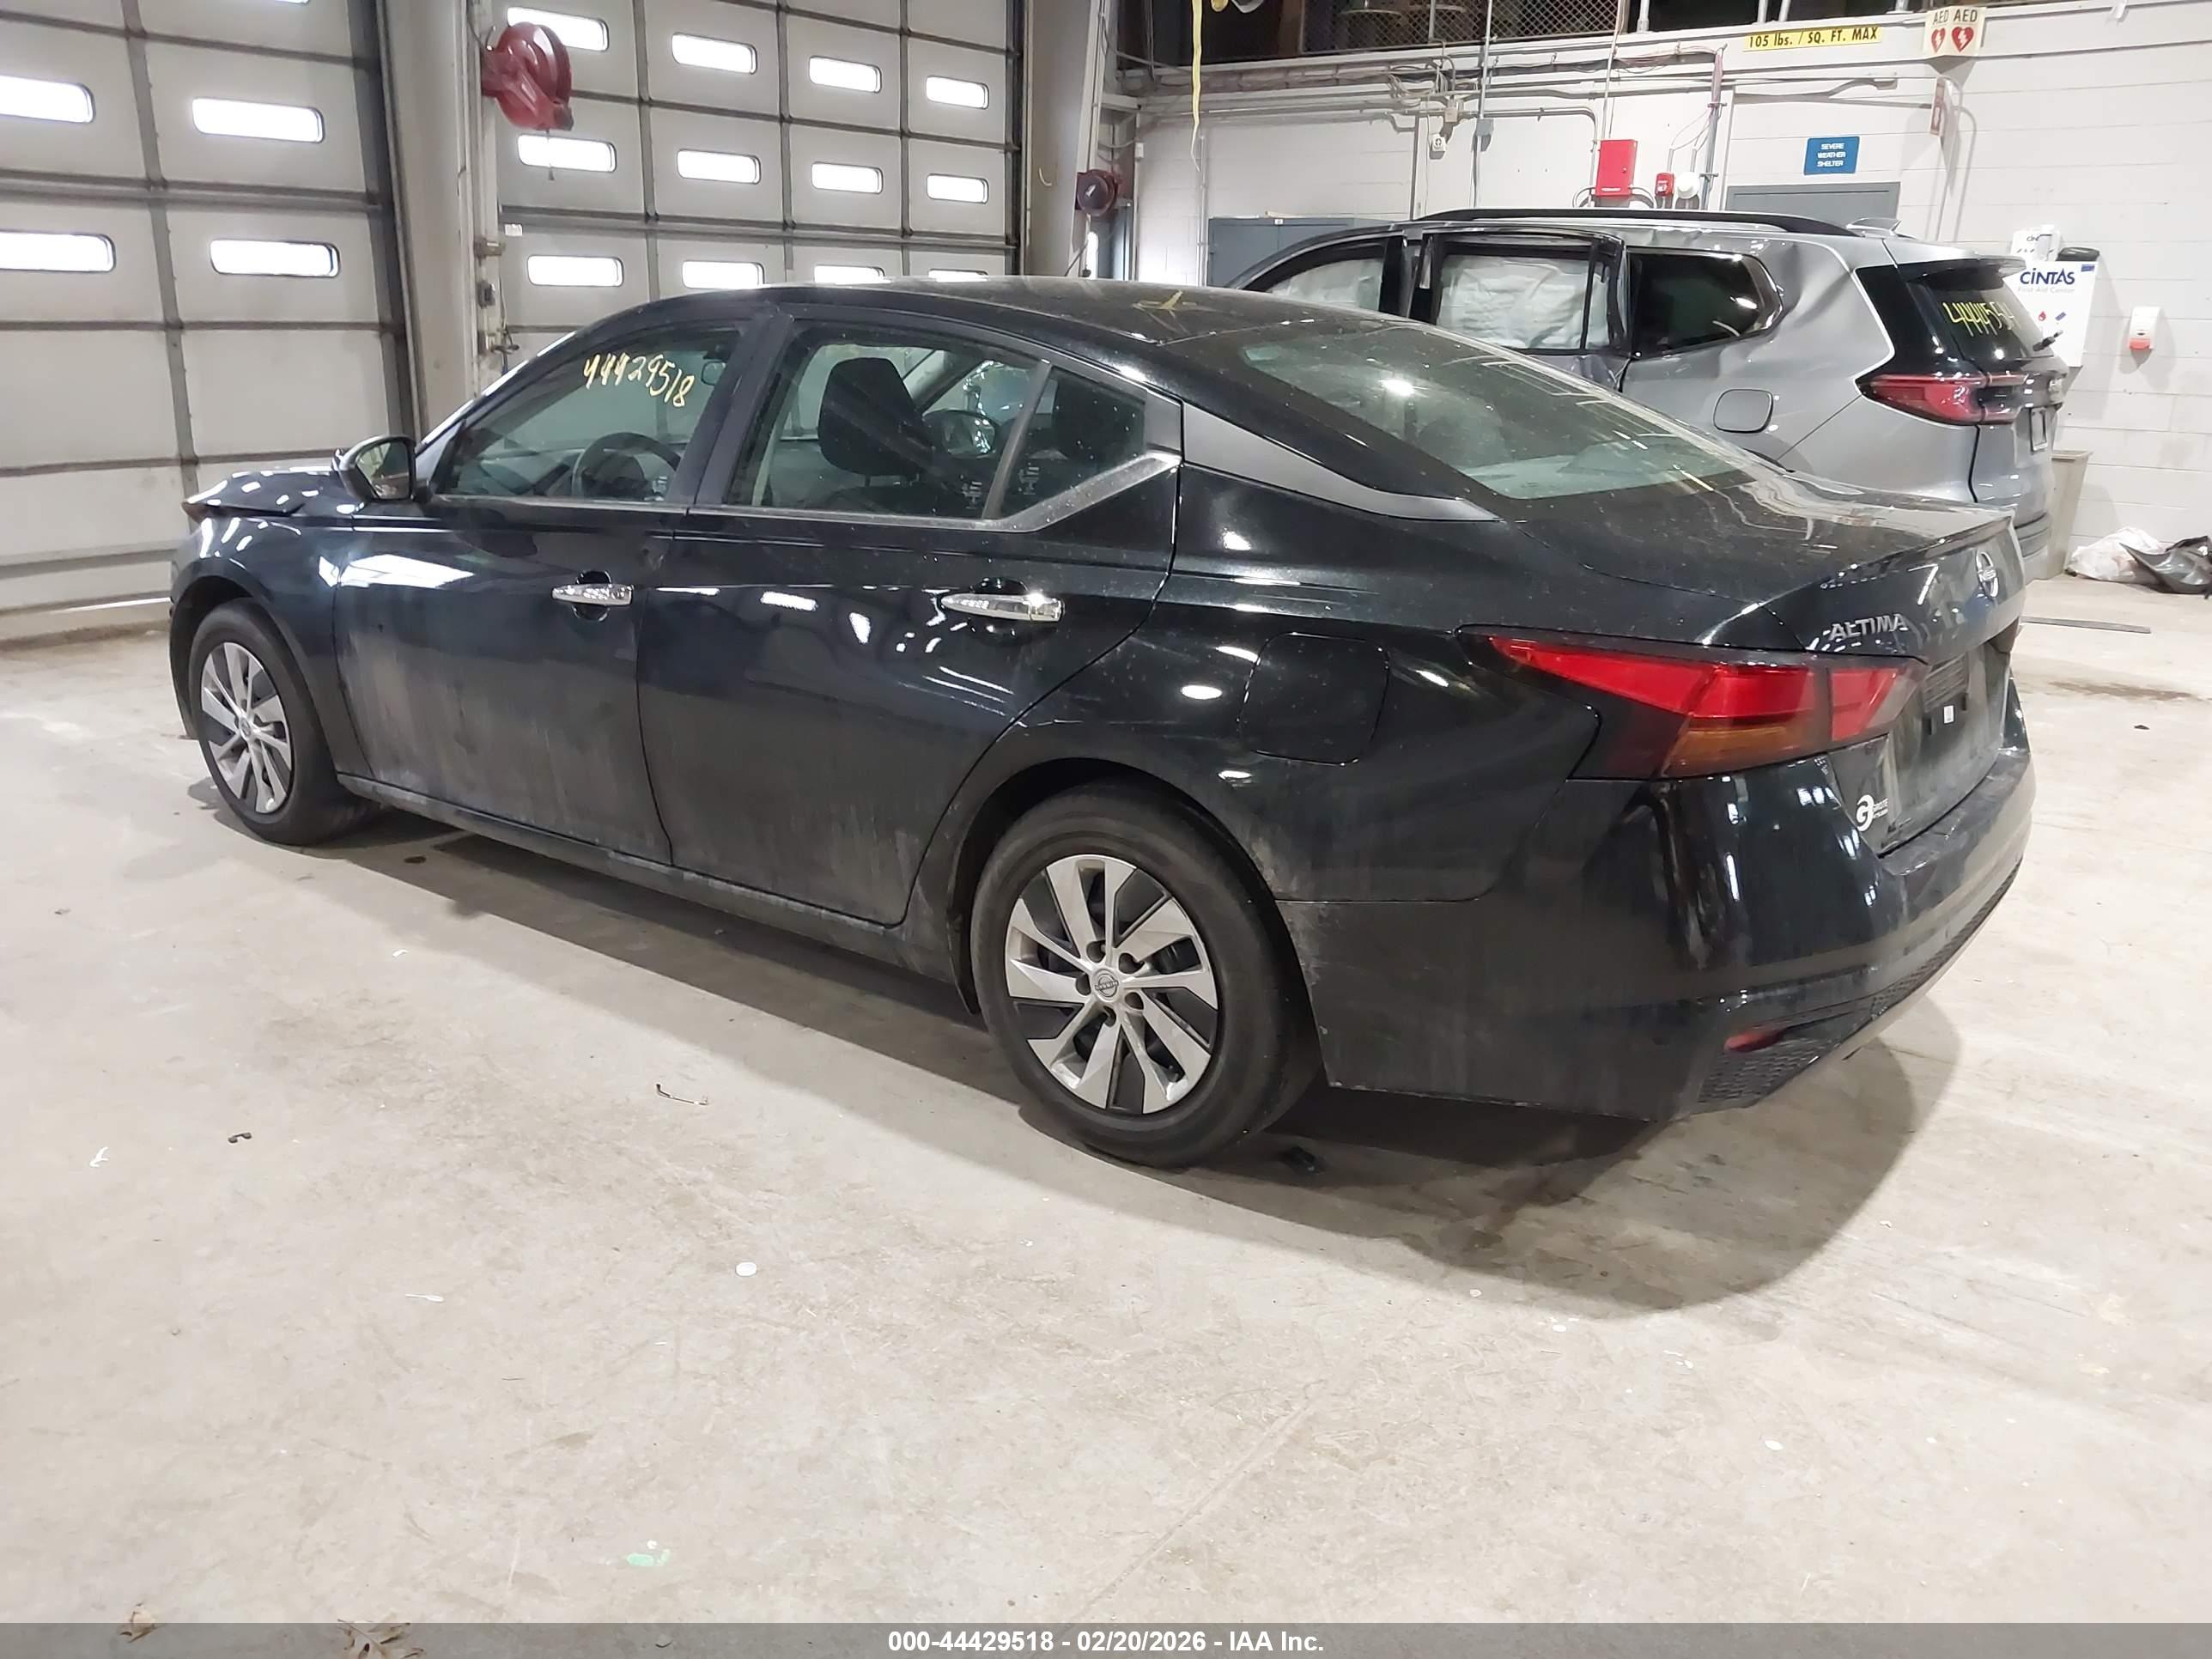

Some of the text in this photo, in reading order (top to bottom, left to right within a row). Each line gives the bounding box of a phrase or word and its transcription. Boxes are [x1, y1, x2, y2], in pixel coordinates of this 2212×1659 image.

[1933, 9, 1950, 25] AED
[1954, 9, 1978, 23] AED
[1750, 35, 1769, 47] 105
[1774, 33, 1793, 46] lbs.
[1808, 32, 1825, 44] SQ.
[1831, 30, 1846, 42] FT.
[1852, 27, 1878, 40] MAX
[2020, 267, 2075, 285] CINTAS
[583, 352, 696, 408] 44429518
[1828, 613, 1906, 641] ALTIMA
